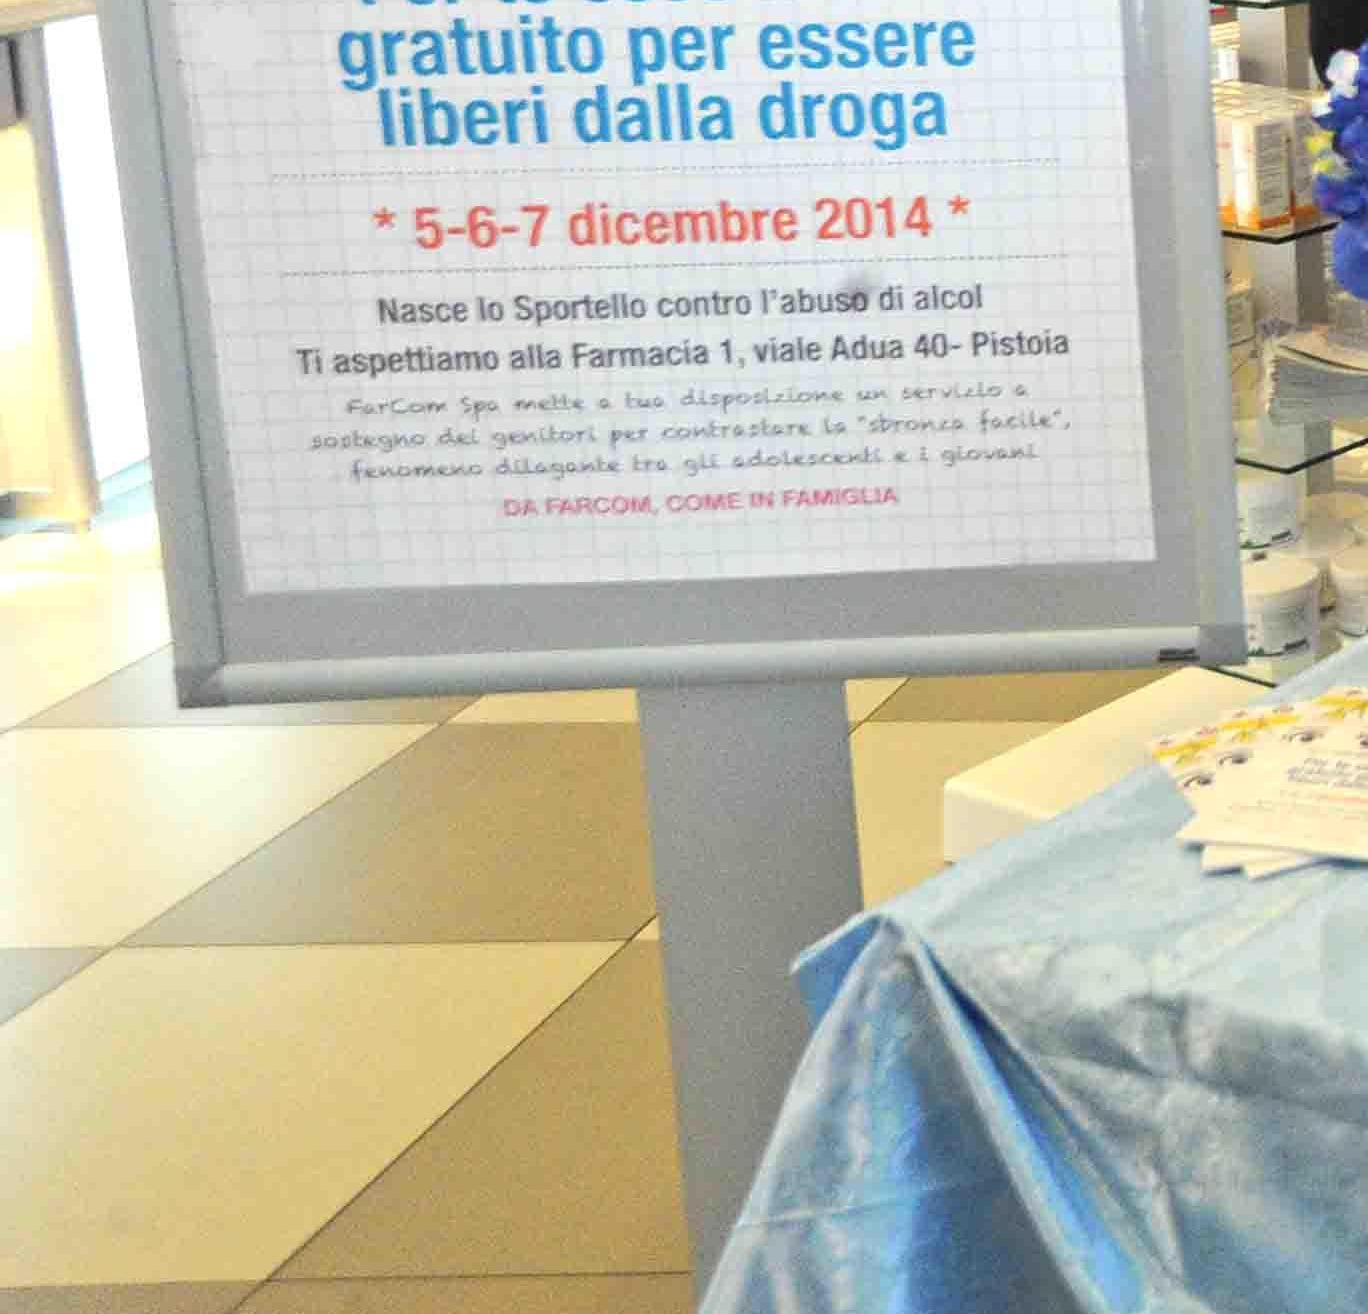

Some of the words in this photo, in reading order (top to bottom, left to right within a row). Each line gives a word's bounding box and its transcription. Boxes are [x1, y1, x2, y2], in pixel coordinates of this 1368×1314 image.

[340, 17, 604, 90] gratuito
[630, 26, 735, 85] per
[760, 21, 975, 75] essere
[380, 86, 547, 144] liberi
[576, 83, 733, 142] dalla
[760, 82, 945, 148] droga
[416, 206, 549, 250] 5-6-7
[569, 202, 797, 245] dicembre
[816, 196, 932, 239] 2014
[376, 298, 468, 324] Nasce
[476, 297, 504, 322] lo
[513, 294, 646, 325] Sportello
[657, 291, 751, 318] contro
[761, 286, 872, 314] l'abuso
[878, 286, 903, 310] di
[914, 284, 982, 310] alcol
[296, 349, 323, 374] Ti
[333, 346, 499, 378] aspettiamo
[509, 344, 561, 370] alla
[572, 340, 709, 369] Farmacia
[753, 337, 822, 363] viale
[831, 335, 904, 361] Adua
[972, 329, 1069, 357] Pistoia
[502, 496, 539, 518] DA
[544, 492, 658, 517] FARCOM,
[665, 492, 743, 513] COME
[749, 491, 775, 510] IN
[781, 486, 898, 510] FAMIGLIA
